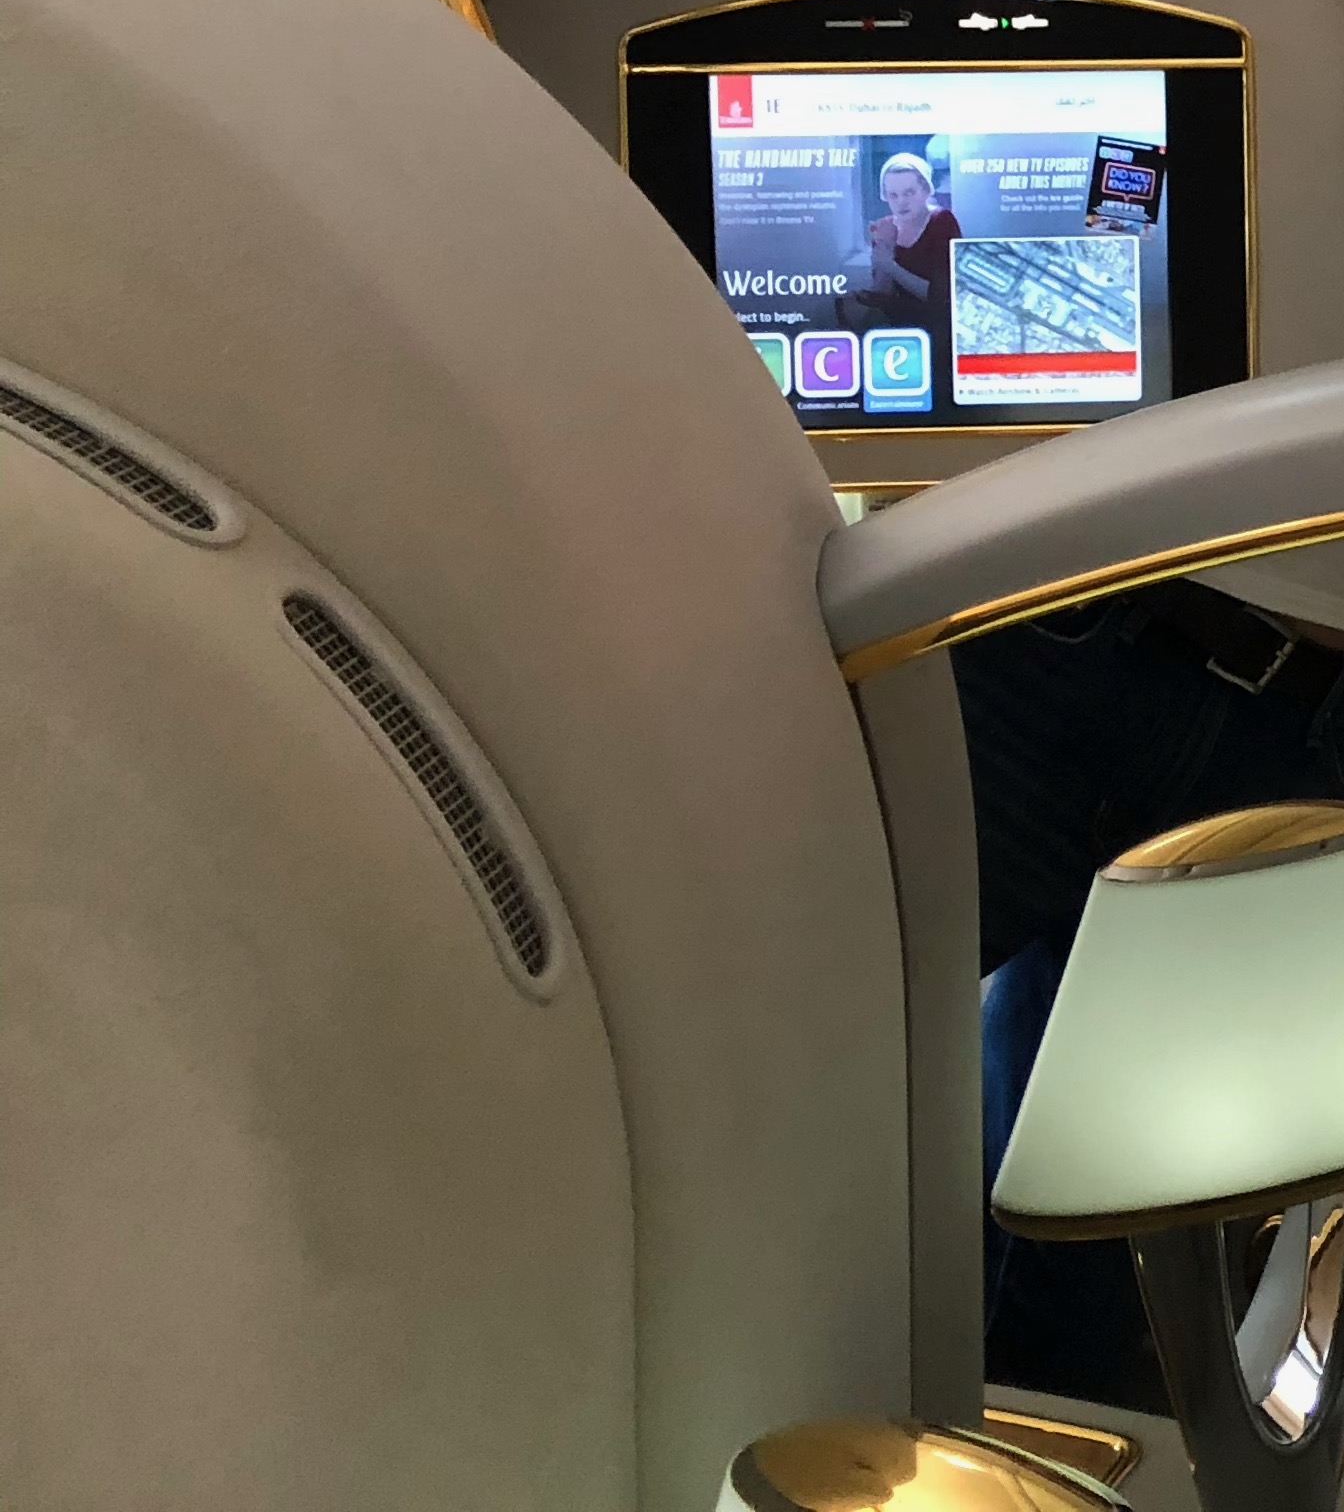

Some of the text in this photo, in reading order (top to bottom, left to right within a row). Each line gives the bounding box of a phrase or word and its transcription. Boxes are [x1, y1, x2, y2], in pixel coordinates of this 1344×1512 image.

[717, 147, 858, 168] THE HANDMAID'S TALE
[1006, 157, 1029, 172] NEW
[1031, 157, 1043, 172] TV
[1044, 157, 1089, 172] EPISODES
[718, 171, 764, 187] SEASON 3
[1109, 167, 1152, 184] DID YOU
[722, 269, 848, 297] Welcome
[760, 312, 772, 323] to
